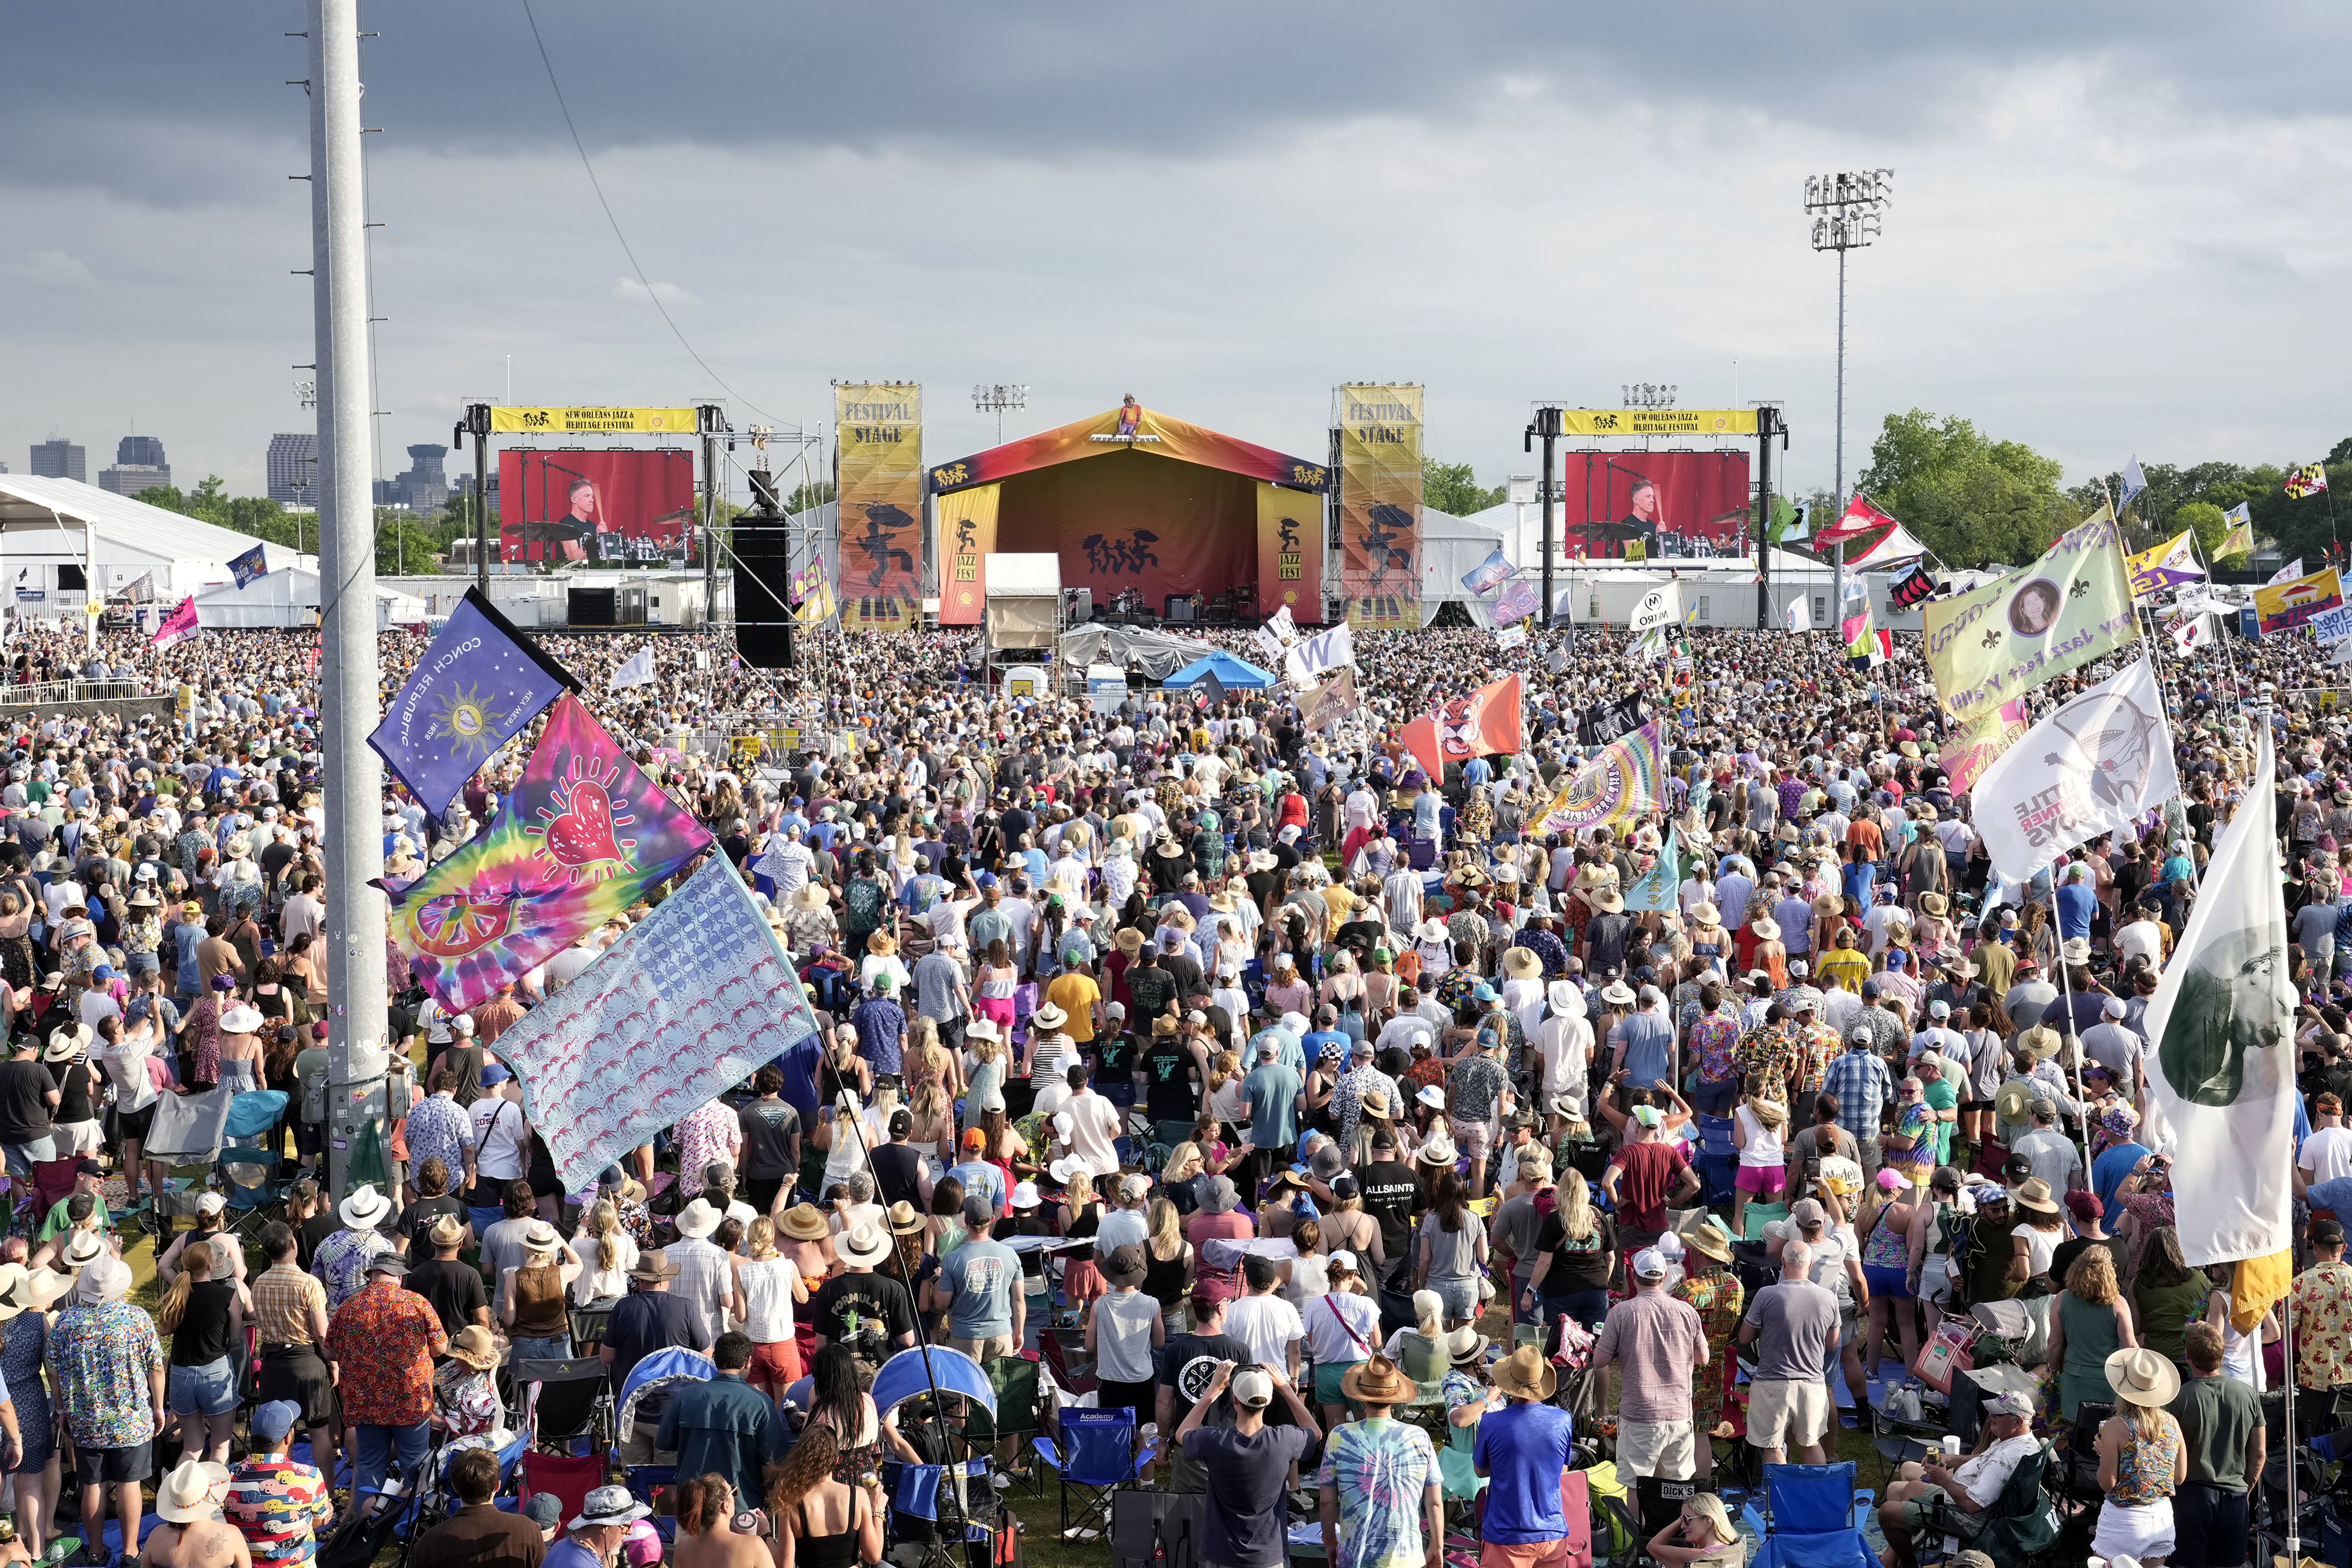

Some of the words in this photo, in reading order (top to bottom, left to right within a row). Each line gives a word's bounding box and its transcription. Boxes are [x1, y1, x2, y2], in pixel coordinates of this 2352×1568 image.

[613, 411, 628, 419] JAZZ
[846, 403, 911, 420] FESTIVAL
[1350, 403, 1414, 420] FESTIVAL
[856, 426, 901, 442] STAGE
[1359, 427, 1404, 443] STAGE
[957, 556, 975, 567] JAZZ
[1279, 555, 1300, 566] JAZZ
[957, 569, 975, 579] FEST
[1280, 567, 1300, 577] FEST
[1297, 633, 1333, 673] W
[1608, 769, 1621, 793] THE
[1590, 794, 1616, 819] BEST
[1825, 1166, 1860, 1181] Modelo
[1366, 1183, 1415, 1194] ALLSAINTS
[831, 1293, 880, 1315] FORMULA
[1664, 1487, 1693, 1496] DICK'S
